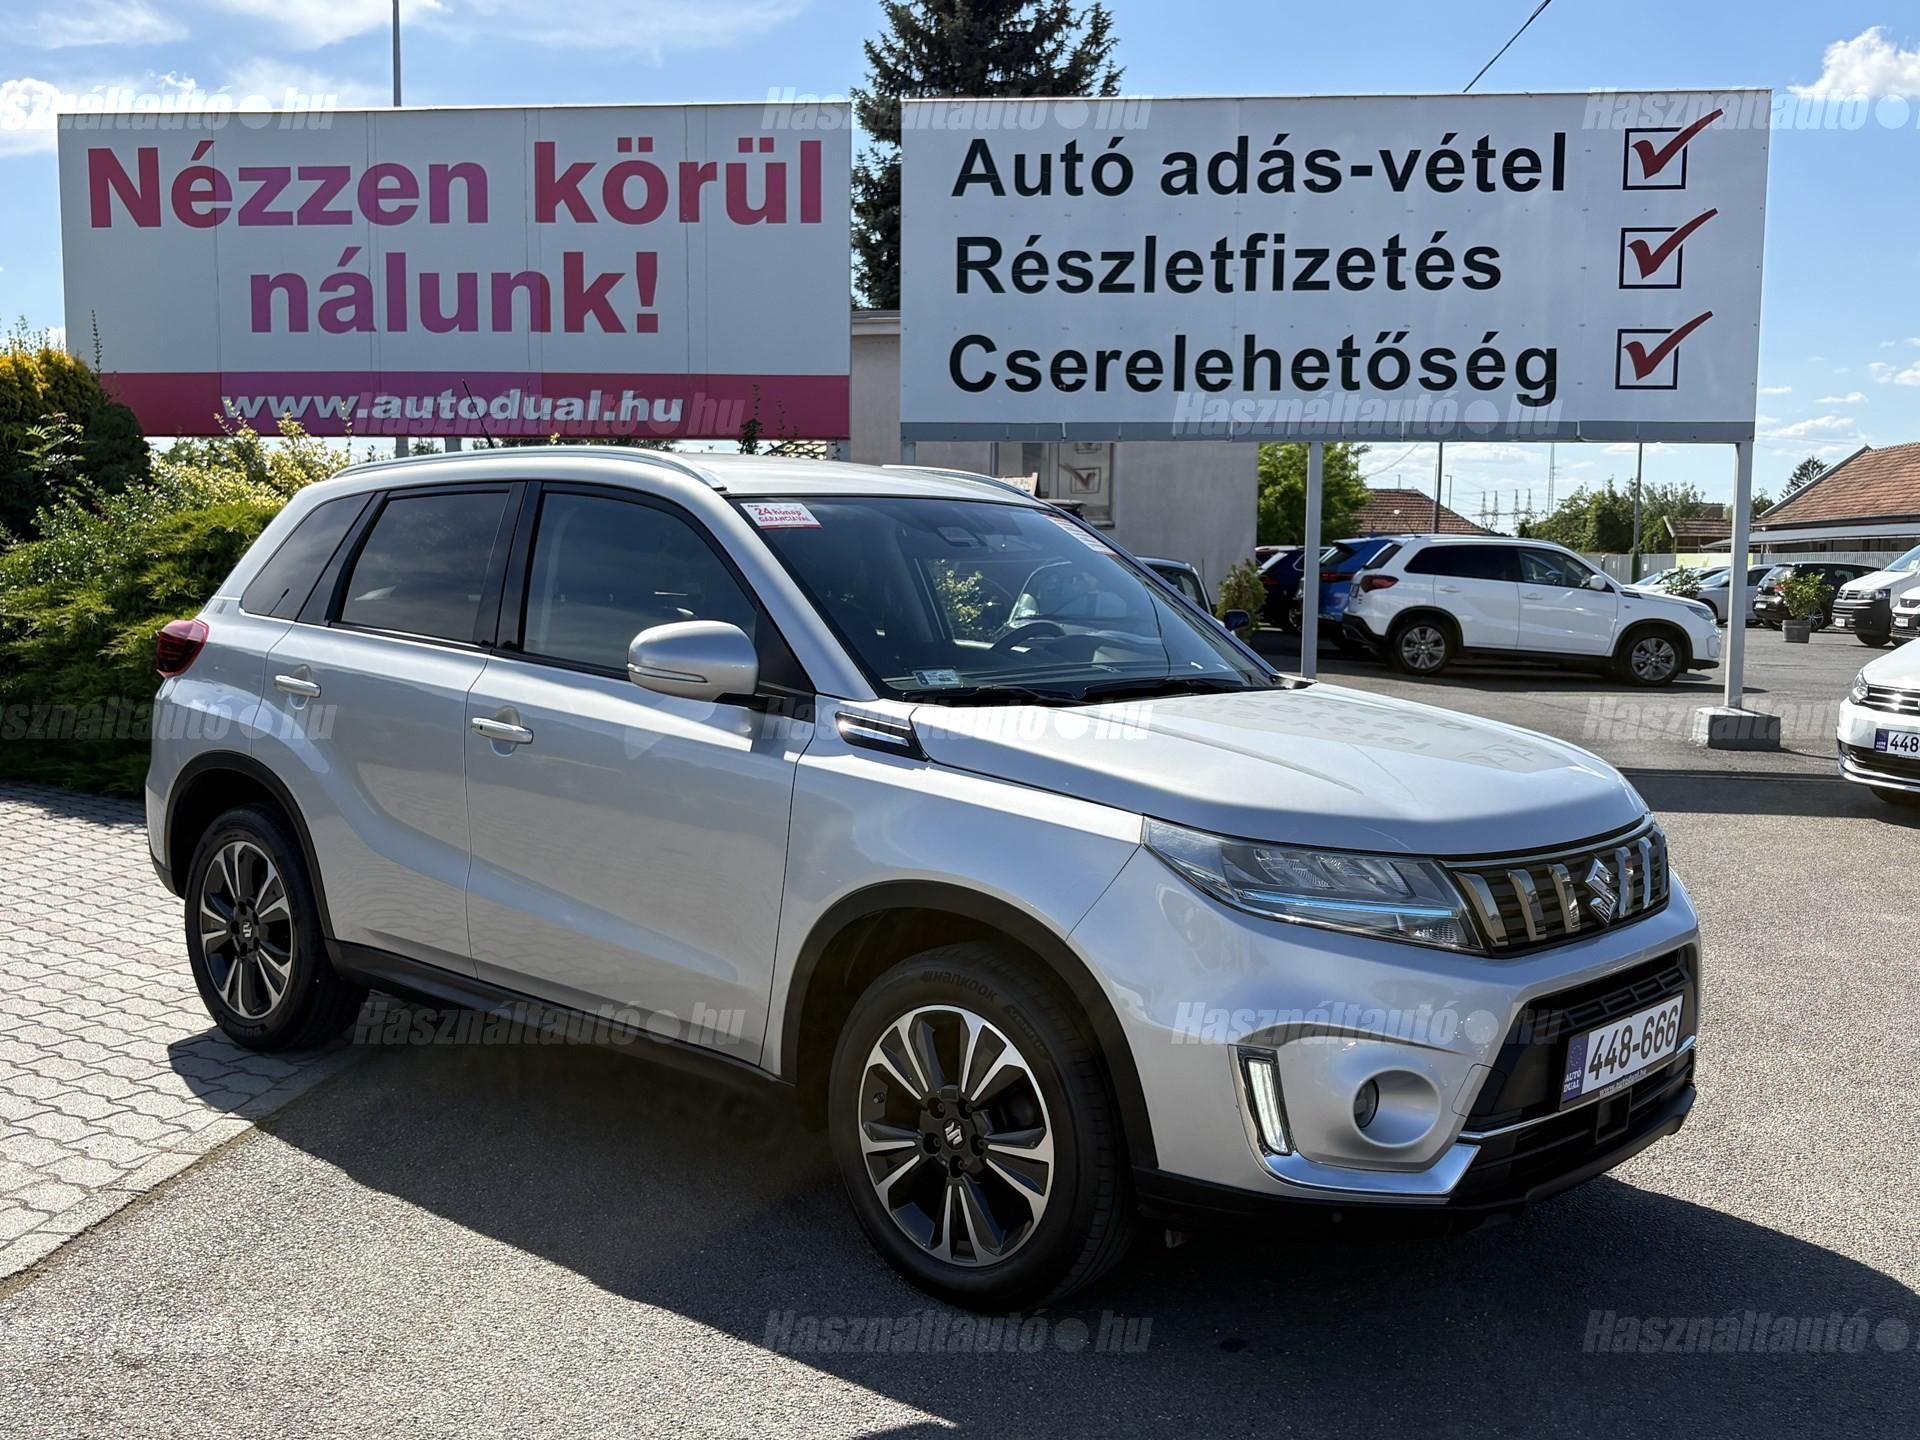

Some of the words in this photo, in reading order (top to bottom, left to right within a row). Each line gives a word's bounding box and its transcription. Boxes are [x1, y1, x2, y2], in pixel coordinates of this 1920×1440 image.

[87, 140, 489, 229] Nézzen
[533, 136, 822, 225] körül
[951, 136, 1134, 197] Autó
[1160, 132, 1567, 195] adás-vétel
[250, 246, 659, 334] nálunk!
[956, 230, 1502, 294] Részletfizetés
[221, 388, 684, 421] www.autodual.hu
[949, 331, 1558, 407] Cserelehetőség
[1588, 1004, 1679, 1081] 448-666
